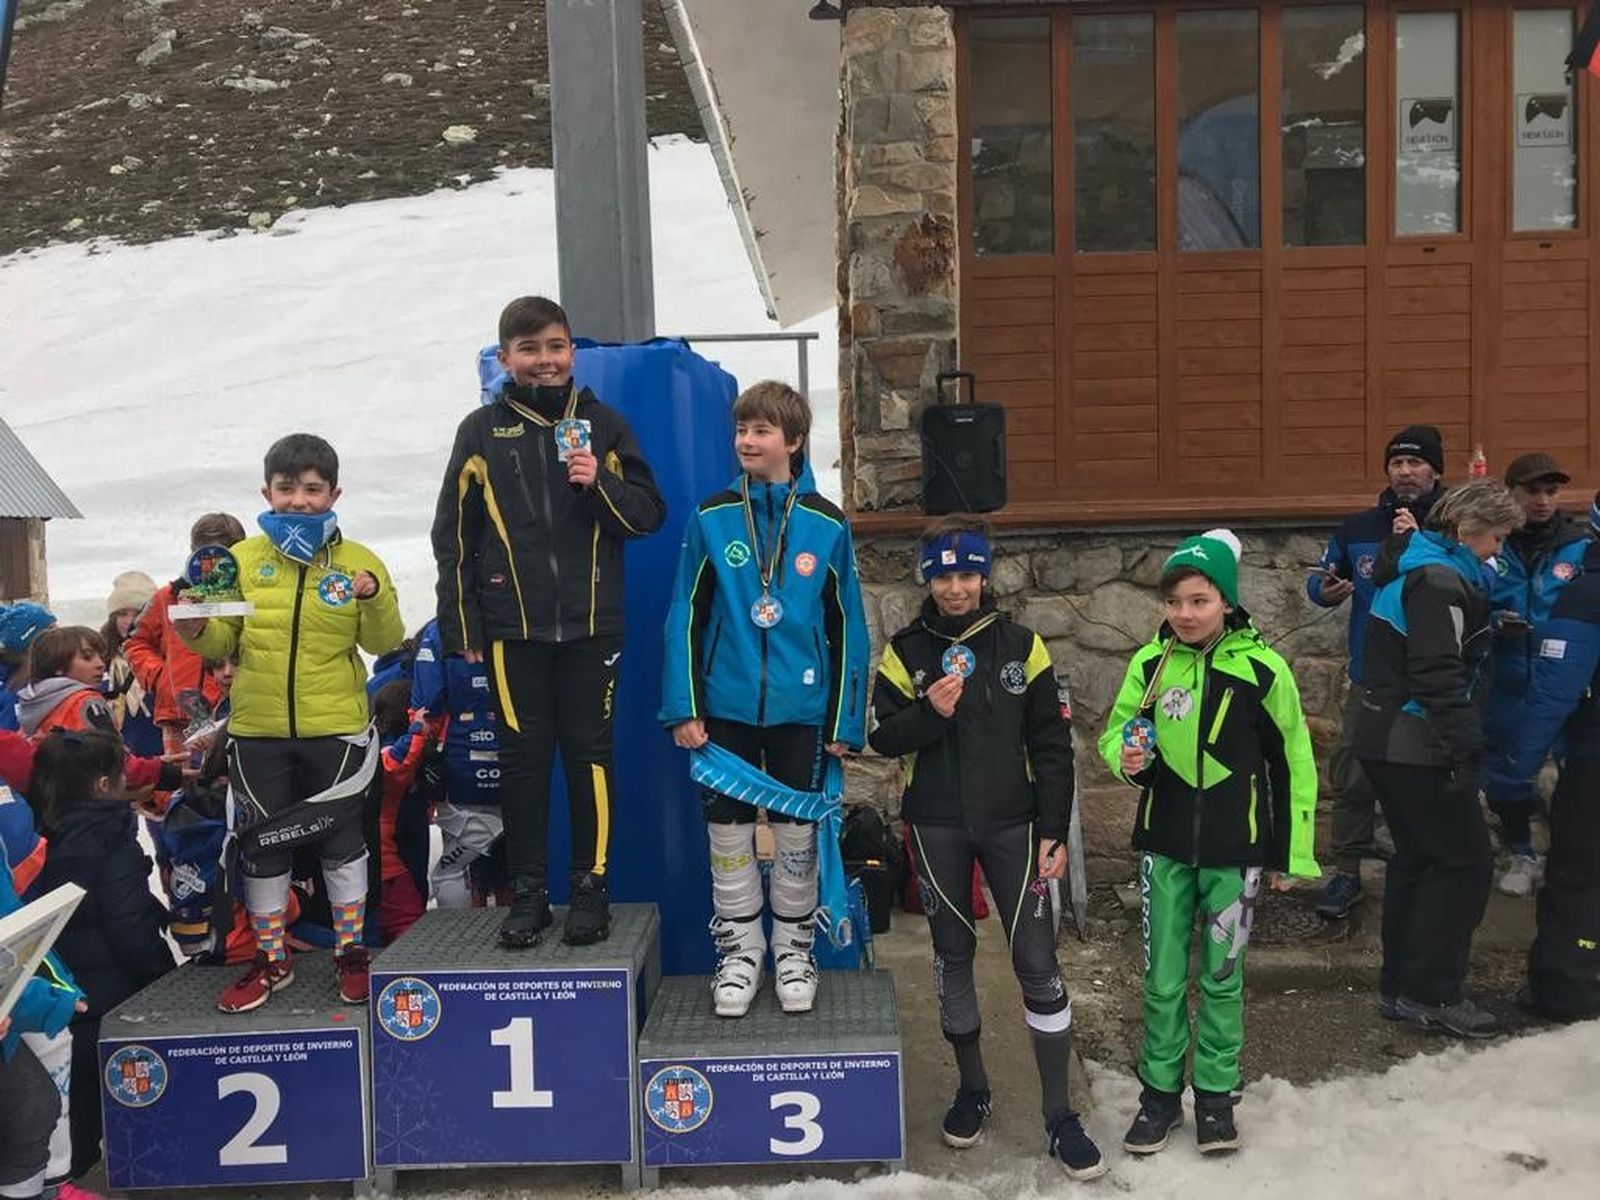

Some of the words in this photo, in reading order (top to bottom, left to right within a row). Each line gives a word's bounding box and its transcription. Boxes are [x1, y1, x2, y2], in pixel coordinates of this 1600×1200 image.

[259, 823, 320, 847] REBELS
[438, 980, 497, 991] FEDERACIÓN
[498, 982, 511, 991] DE
[512, 981, 560, 991] DEPORTES
[562, 981, 574, 989] DE
[576, 980, 622, 989] INVIERNO
[484, 993, 497, 1001] DE
[499, 992, 542, 1001] CASTILLA
[543, 992, 550, 1000] Y
[552, 990, 576, 1000] LEÓN
[168, 1046, 226, 1058] FEDERACIÓN
[229, 1046, 241, 1055] DE
[243, 1043, 290, 1054] DEPORTES
[292, 1042, 305, 1051] DE
[307, 1040, 352, 1050] INVIERNO
[215, 1057, 227, 1065] DE
[229, 1055, 273, 1064] CASTILLA
[274, 1054, 281, 1062] Y
[283, 1052, 307, 1062] LEÓN
[490, 1017, 553, 1108] 1
[706, 1062, 764, 1073] FEDERACIÓN
[766, 1063, 779, 1071] DE
[780, 1061, 828, 1071] DEPORTES
[830, 1060, 842, 1069] DE
[844, 1059, 891, 1069] INVIERNO
[753, 1074, 765, 1082] DE
[767, 1072, 810, 1081] CASTILLA
[811, 1072, 818, 1080] Y
[820, 1070, 845, 1080] LEÓN
[217, 1071, 287, 1165] 2
[769, 1090, 825, 1156] 3
